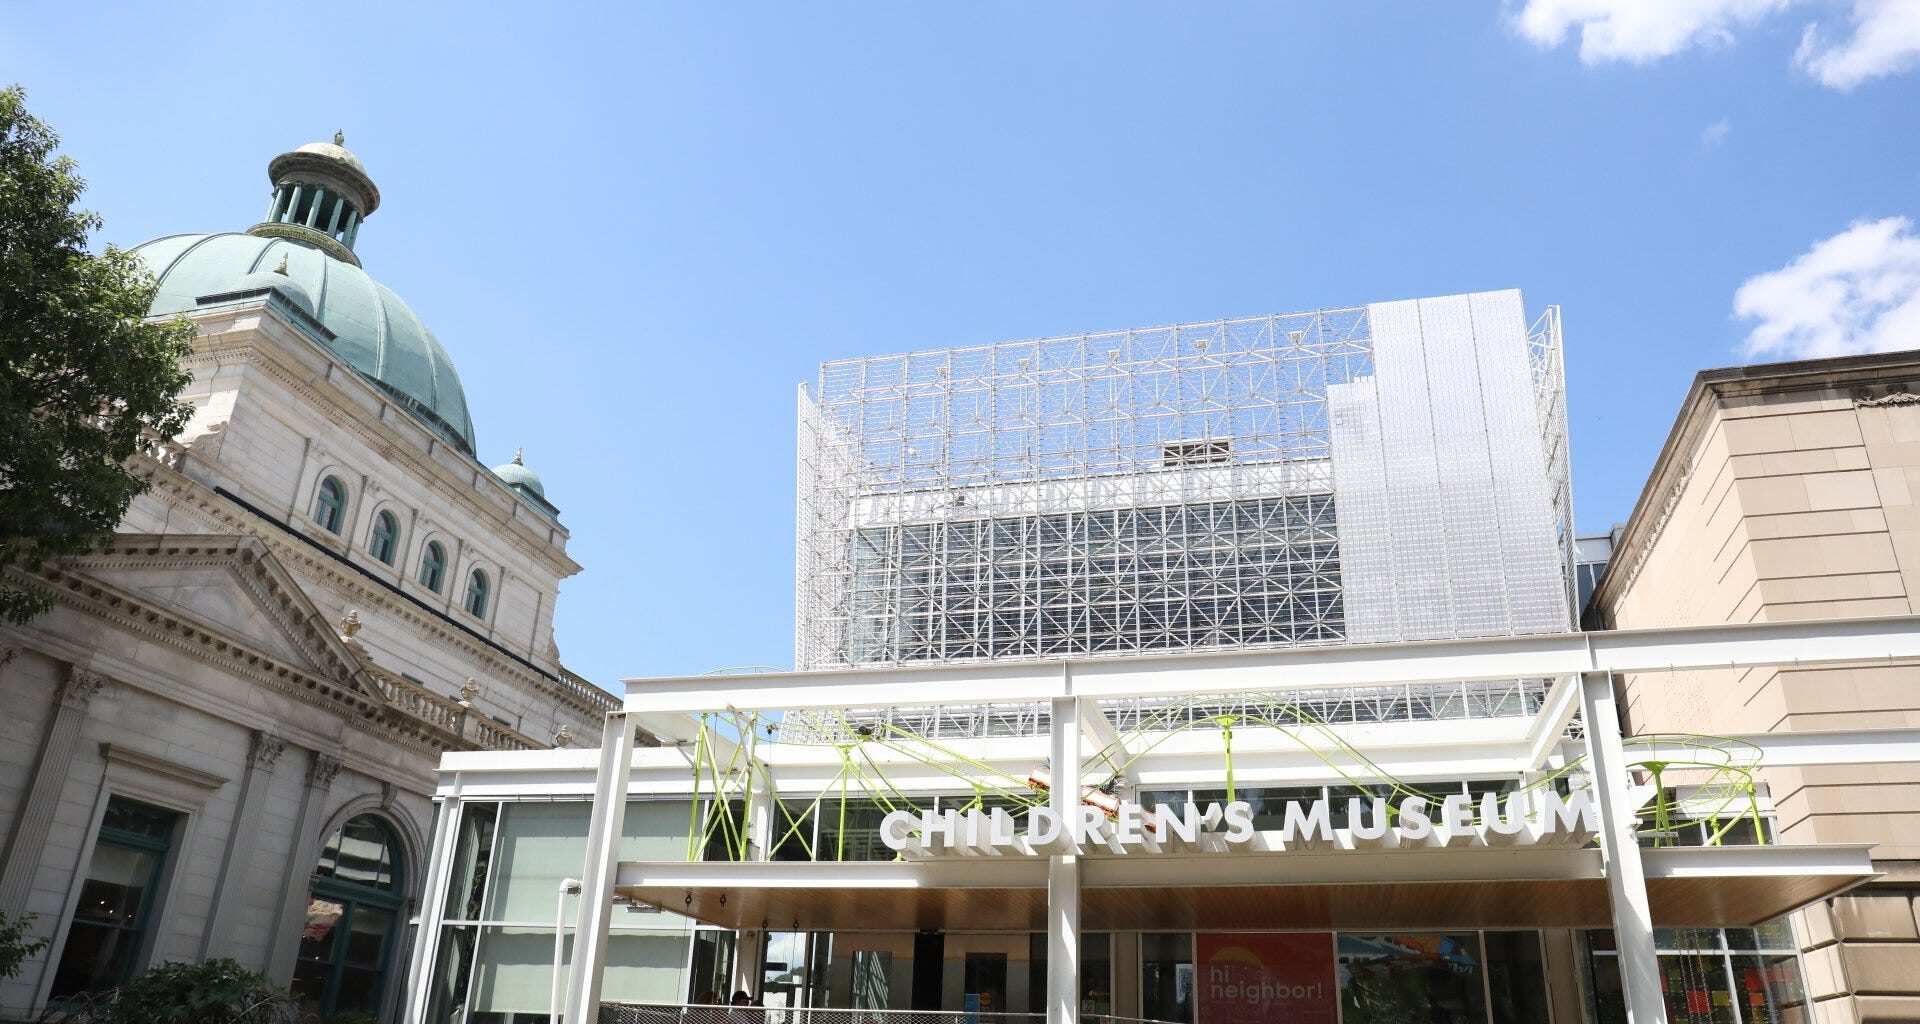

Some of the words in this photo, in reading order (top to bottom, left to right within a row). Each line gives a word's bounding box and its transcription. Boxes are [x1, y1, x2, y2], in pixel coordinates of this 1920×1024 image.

[880, 801, 1254, 850] CHILDREN'S
[1283, 791, 1597, 841] MUSEUM
[1210, 965, 1230, 983] hi
[1211, 980, 1322, 1004] neighbor!
